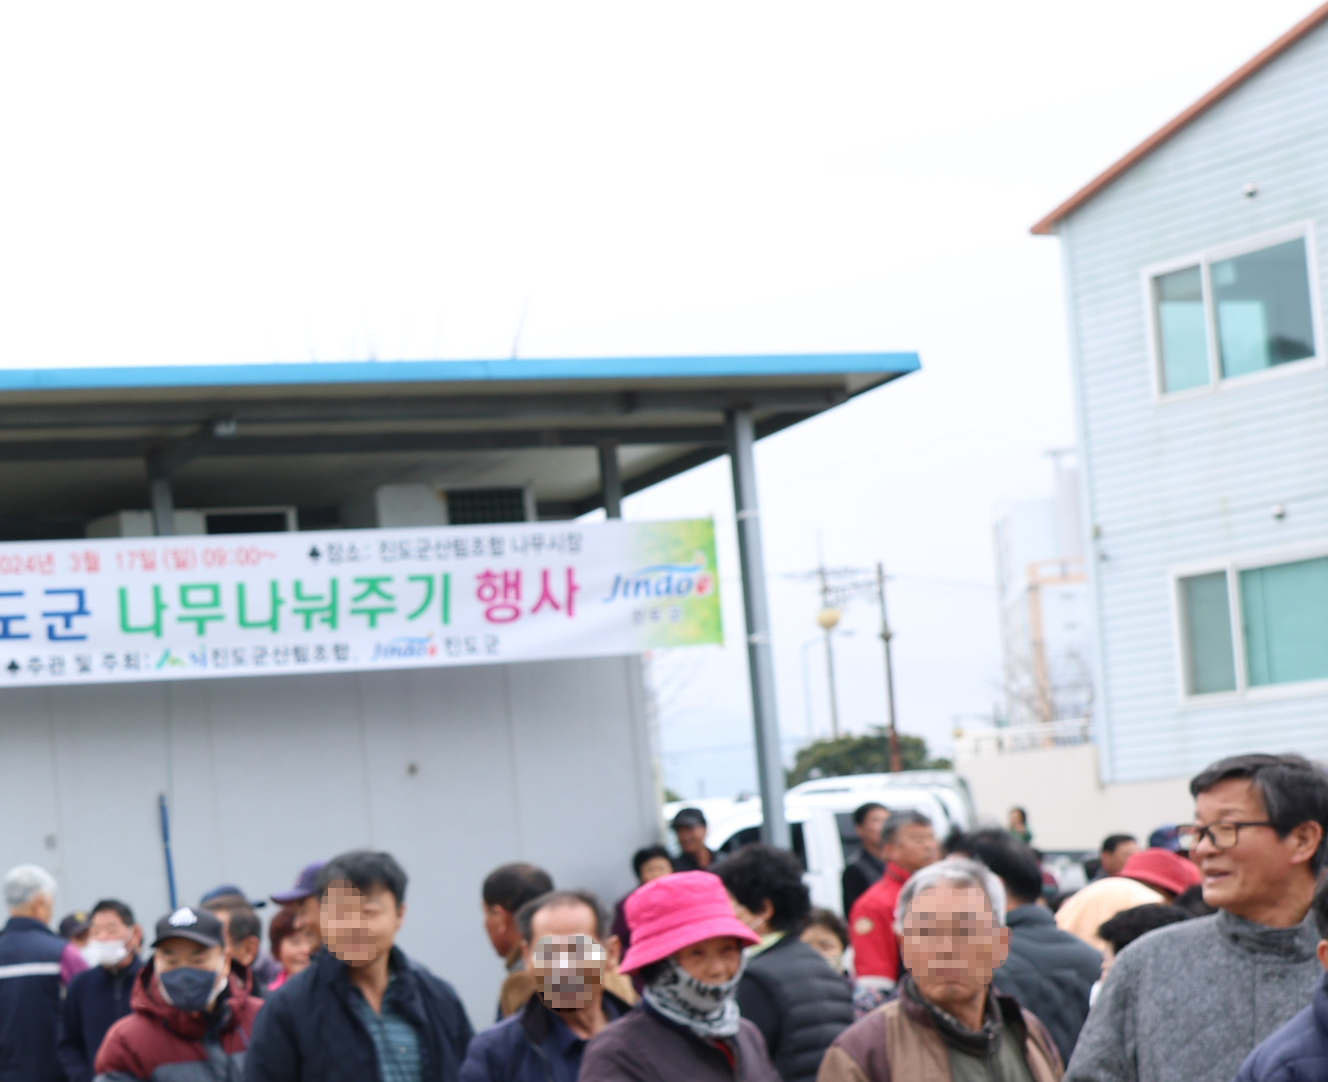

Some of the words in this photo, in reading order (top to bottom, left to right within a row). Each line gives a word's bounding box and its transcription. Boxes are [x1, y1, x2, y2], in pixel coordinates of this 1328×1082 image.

[380, 536, 504, 562] 진도군산림조합
[511, 531, 584, 556] 나무시장
[70, 550, 100, 573] 3월
[118, 572, 450, 638] 나무나눠주기
[475, 566, 581, 625] 행사
[444, 635, 500, 657] 진도군
